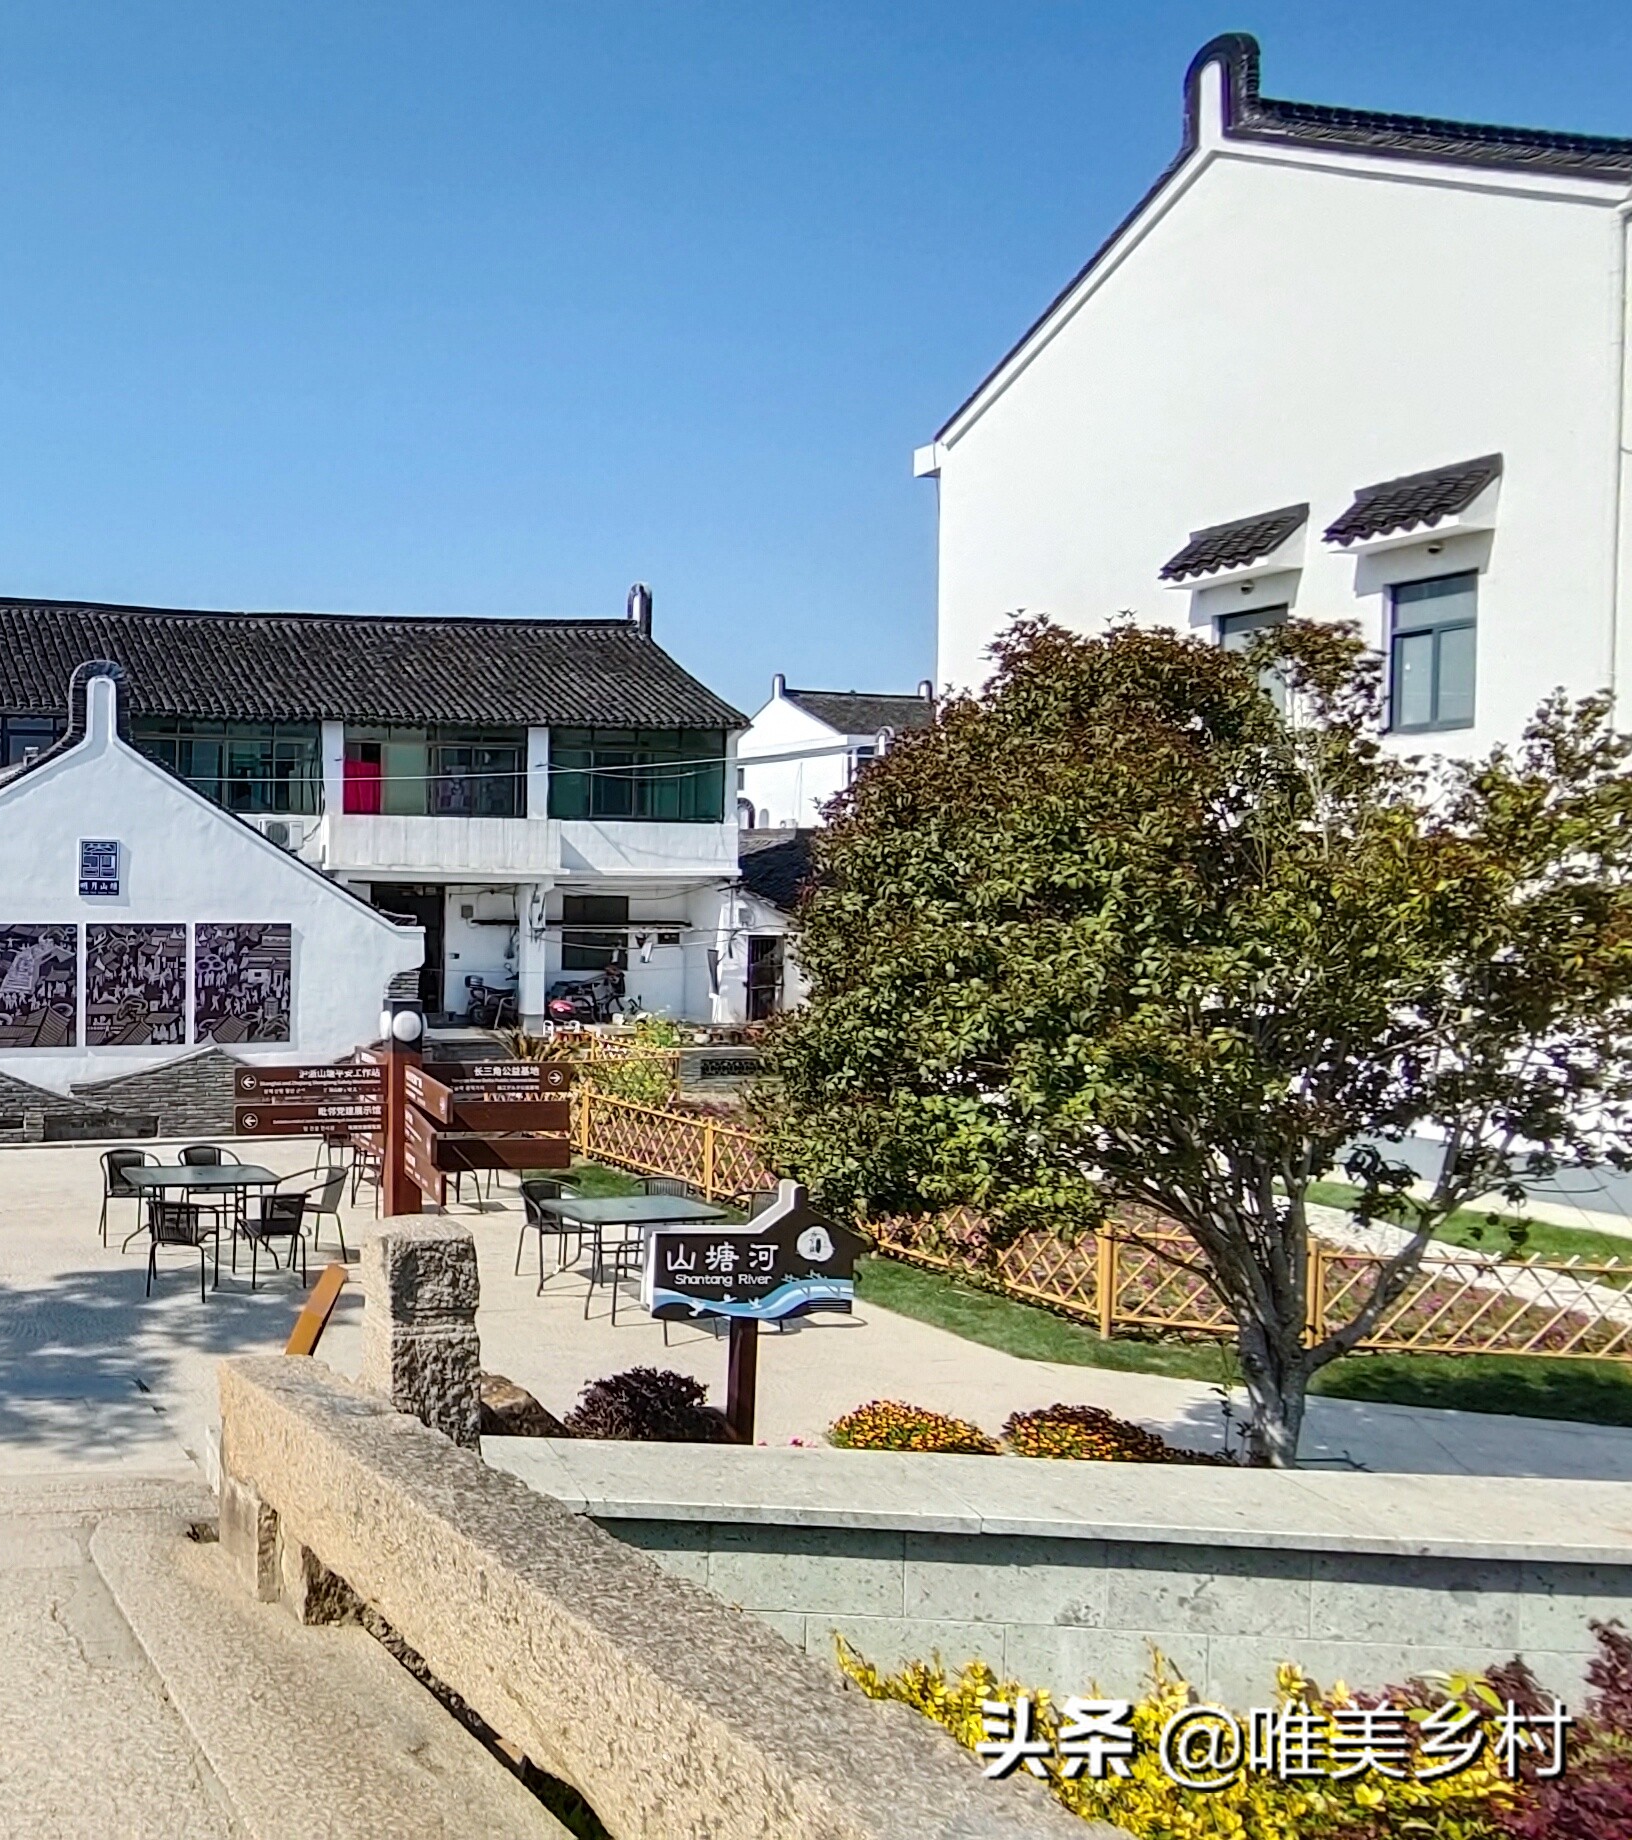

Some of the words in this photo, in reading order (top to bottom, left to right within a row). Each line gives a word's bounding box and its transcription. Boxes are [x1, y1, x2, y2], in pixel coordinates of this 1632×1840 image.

[474, 1066, 540, 1076] 长三角公益基地
[317, 1105, 382, 1116] 毗邻党建展示馆
[666, 1241, 779, 1273] 山塘河
[674, 1273, 734, 1287] Shantang
[738, 1273, 773, 1285] River
